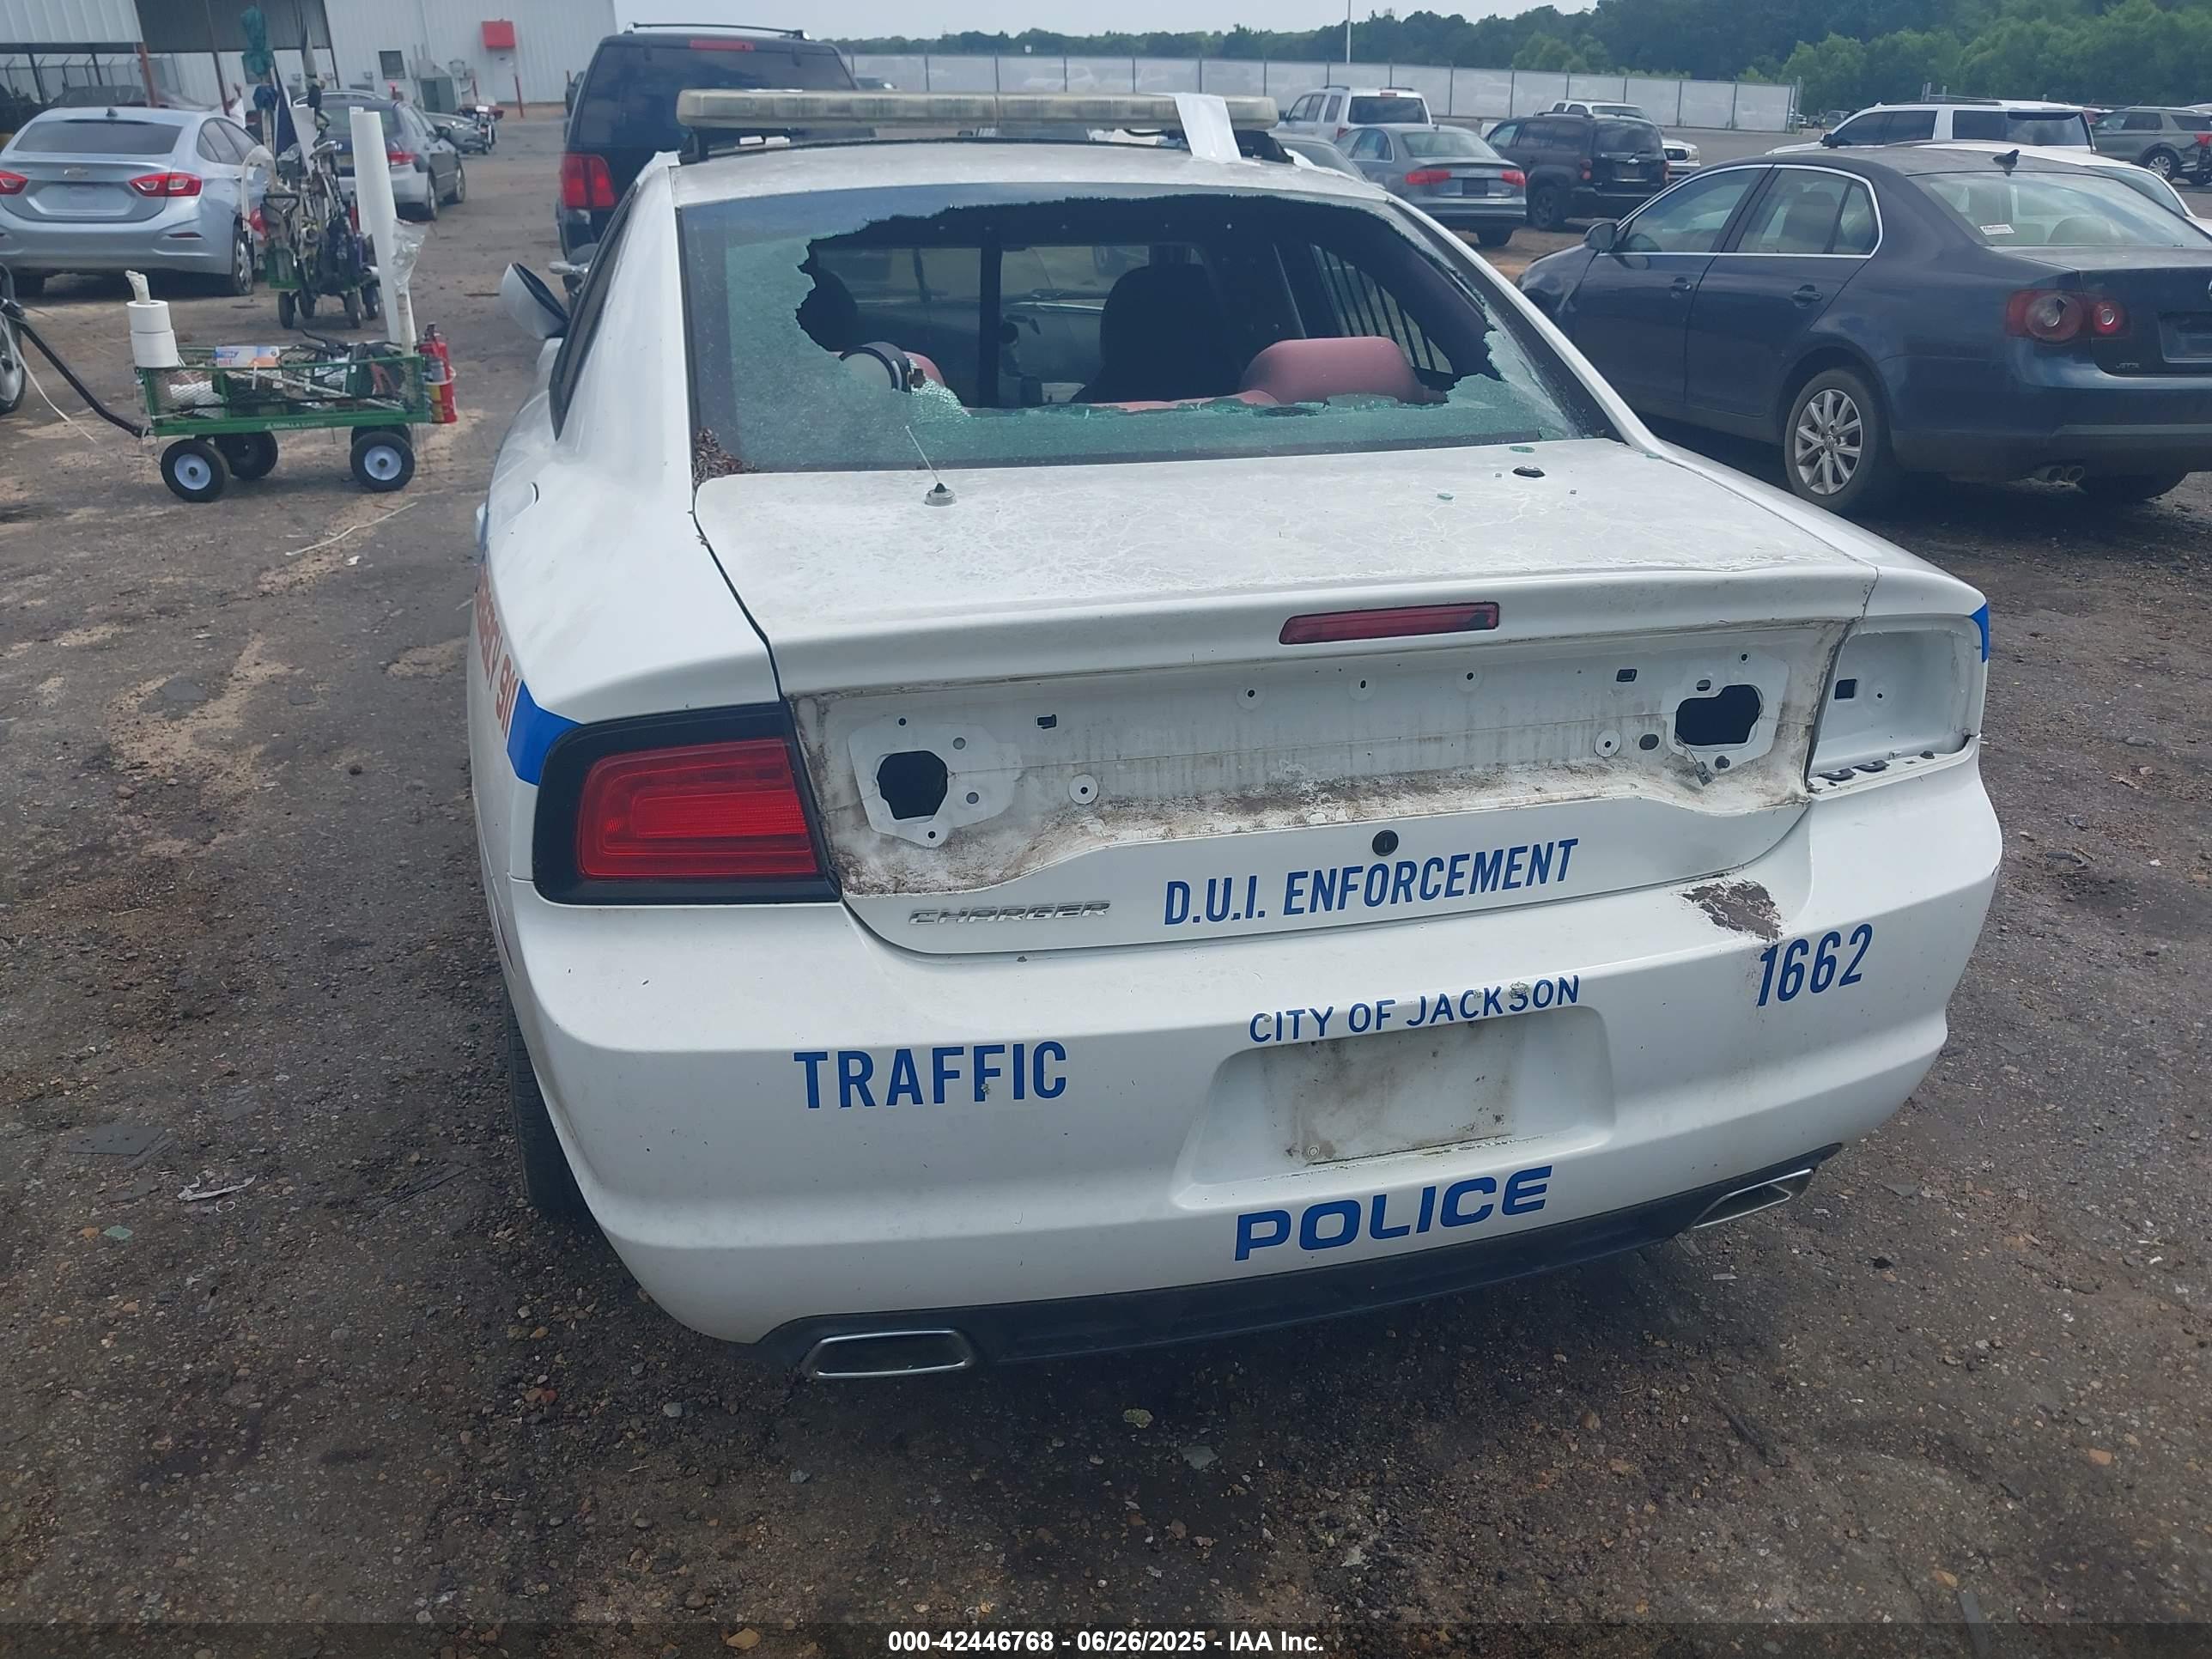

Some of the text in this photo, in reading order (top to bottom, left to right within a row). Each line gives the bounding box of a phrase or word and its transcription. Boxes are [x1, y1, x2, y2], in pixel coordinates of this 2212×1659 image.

[908, 900, 1111, 925] CHARGER
[1164, 838, 1578, 926] D.U.I. ENFORCEMENT
[1757, 923, 1874, 1006] 1662
[1249, 975, 1579, 1044] CITY OF JACKSON
[793, 1041, 1067, 1109] TRAFFIC
[1234, 1165, 1553, 1261] POLICE
